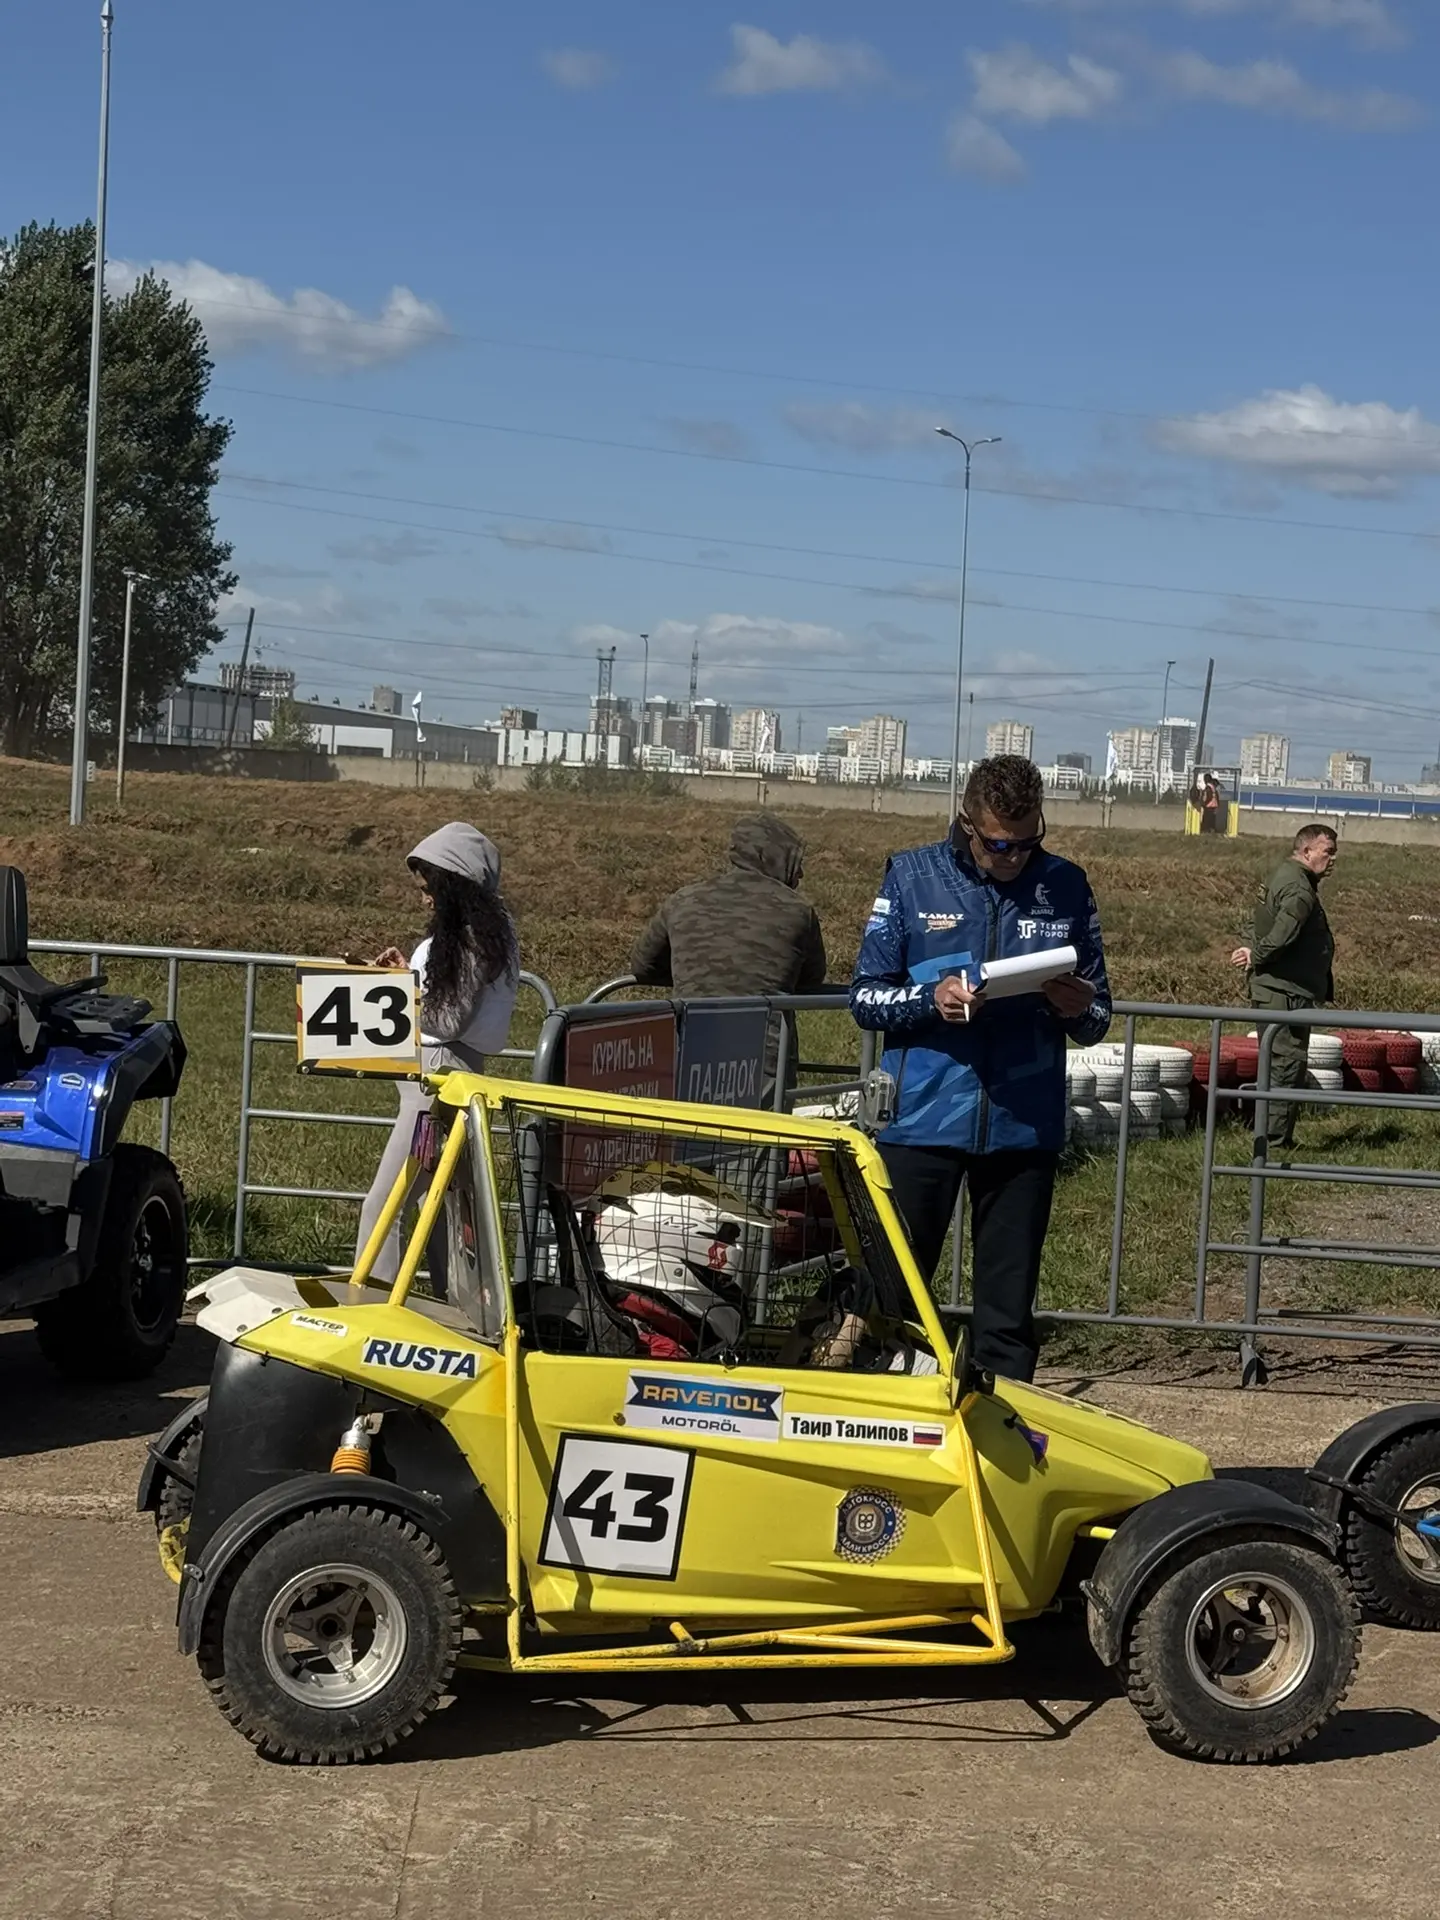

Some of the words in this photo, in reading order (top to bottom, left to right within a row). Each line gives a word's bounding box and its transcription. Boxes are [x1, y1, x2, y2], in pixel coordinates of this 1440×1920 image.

[918, 911, 964, 920] KAMAZ
[306, 985, 412, 1047] 43
[592, 1038, 636, 1076] КУРИТЬ
[638, 1034, 654, 1067] НА
[689, 1059, 758, 1105] ПАДДОК
[363, 1338, 477, 1379] RUSTA
[642, 1384, 767, 1413] RAVENOL
[661, 1415, 741, 1433] MOTORÖL
[791, 1416, 833, 1437] Таир
[836, 1420, 909, 1442] Талипов
[562, 1469, 675, 1543] 43
[842, 1495, 892, 1514] АВТОКРОСС
